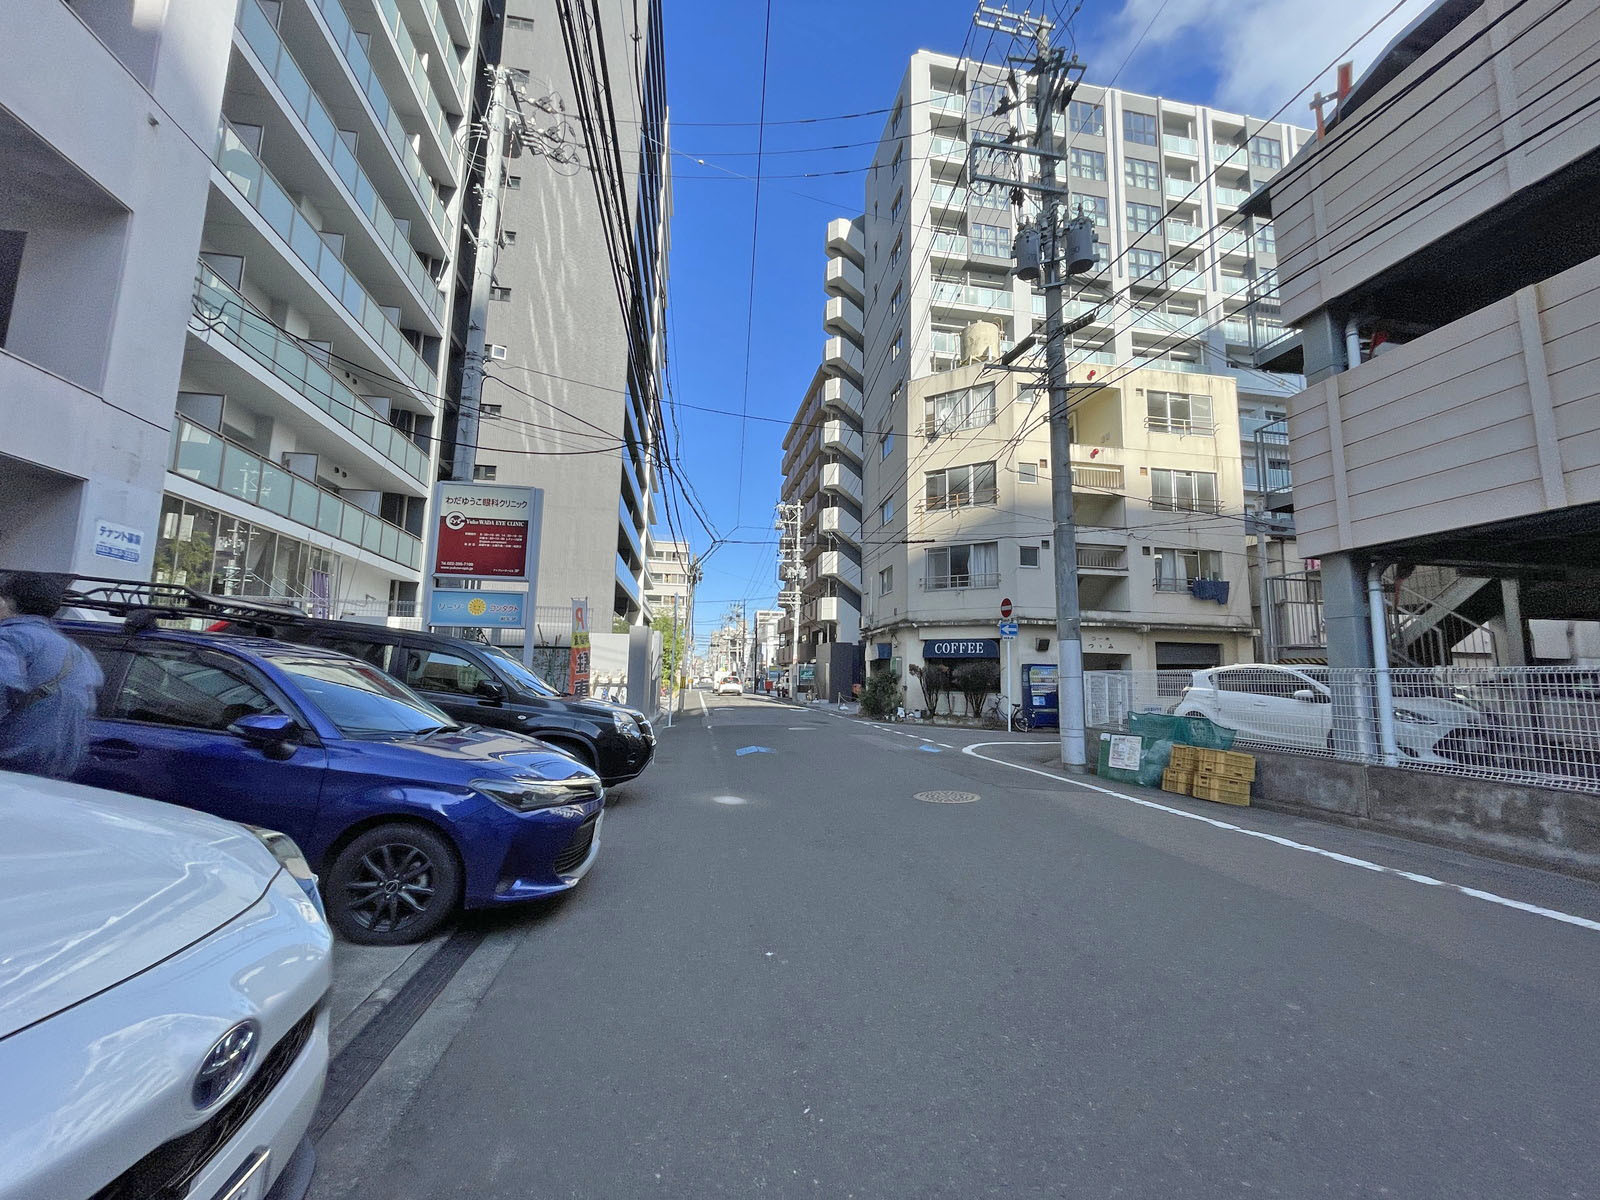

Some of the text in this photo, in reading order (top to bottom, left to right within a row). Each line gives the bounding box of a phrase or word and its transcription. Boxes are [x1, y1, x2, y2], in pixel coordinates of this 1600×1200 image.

[445, 496, 528, 508] わだゆうこ眼科クリニック
[934, 642, 984, 654] COFFEE
